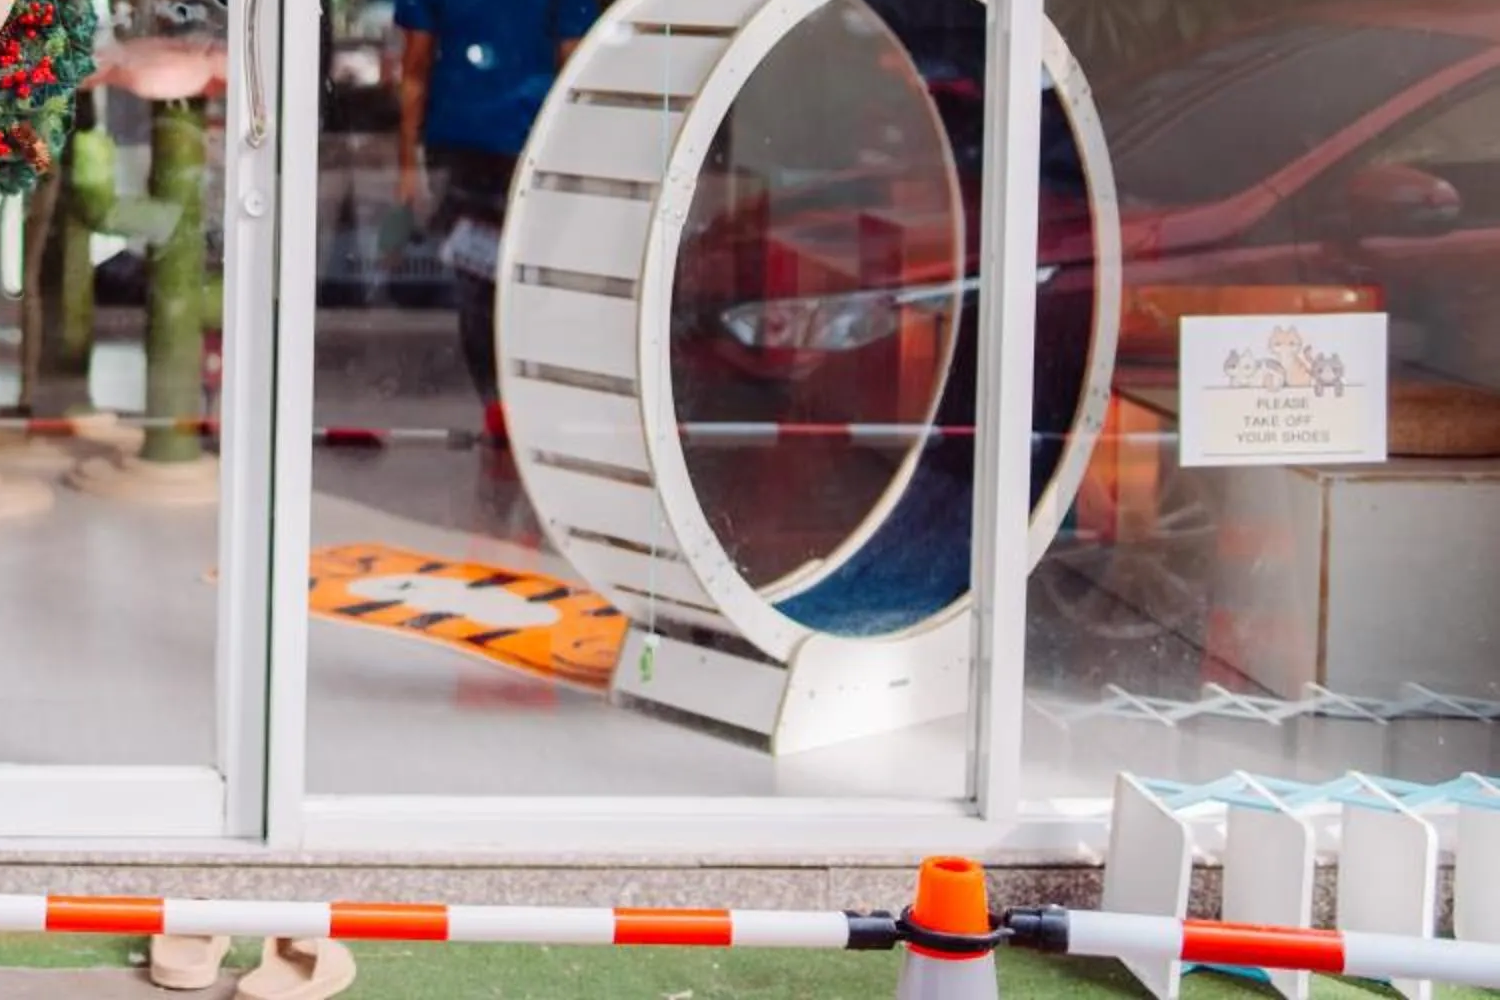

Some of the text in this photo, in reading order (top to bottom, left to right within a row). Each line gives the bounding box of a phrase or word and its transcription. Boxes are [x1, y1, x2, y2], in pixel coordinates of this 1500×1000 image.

[1256, 396, 1310, 410] PLEASE
[1243, 414, 1312, 427] TAKE OFF
[1236, 430, 1331, 444] YOUR SHOES
